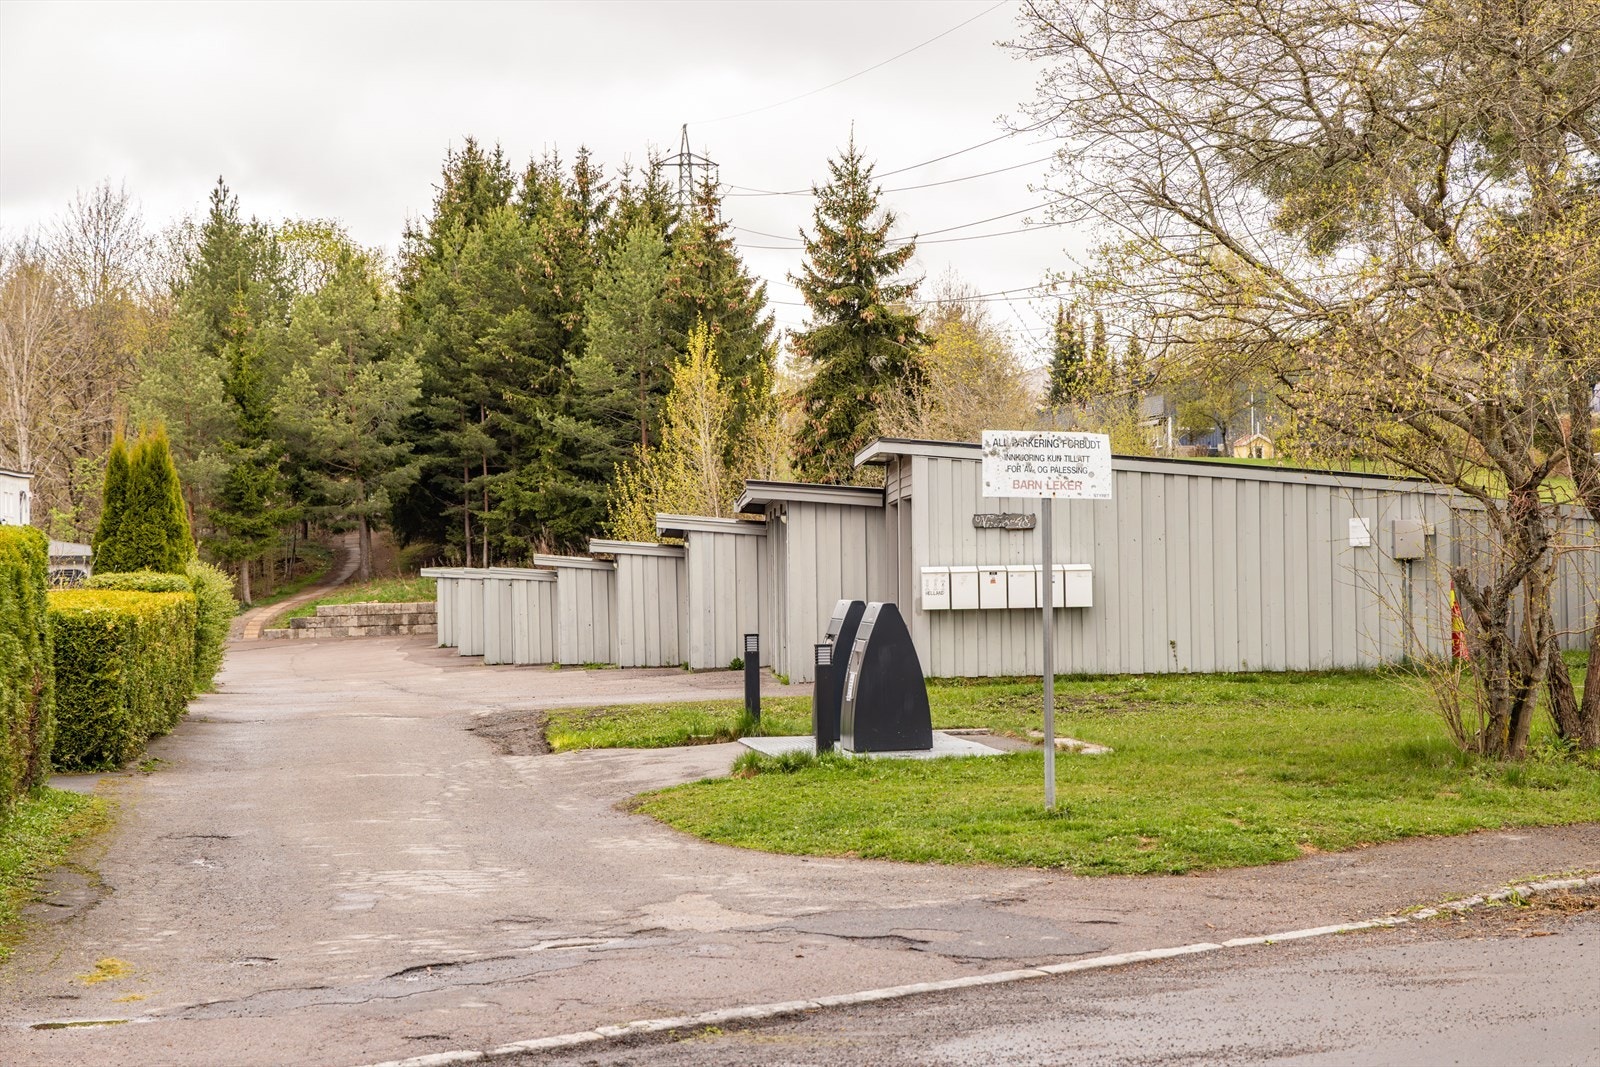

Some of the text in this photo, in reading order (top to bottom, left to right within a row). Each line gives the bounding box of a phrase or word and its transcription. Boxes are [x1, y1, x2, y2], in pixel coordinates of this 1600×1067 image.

[993, 438, 1101, 449] ALL PARKERING FORBUDT
[1064, 455, 1090, 463] TILLATT
[1012, 479, 1082, 490] BARN LEKER
